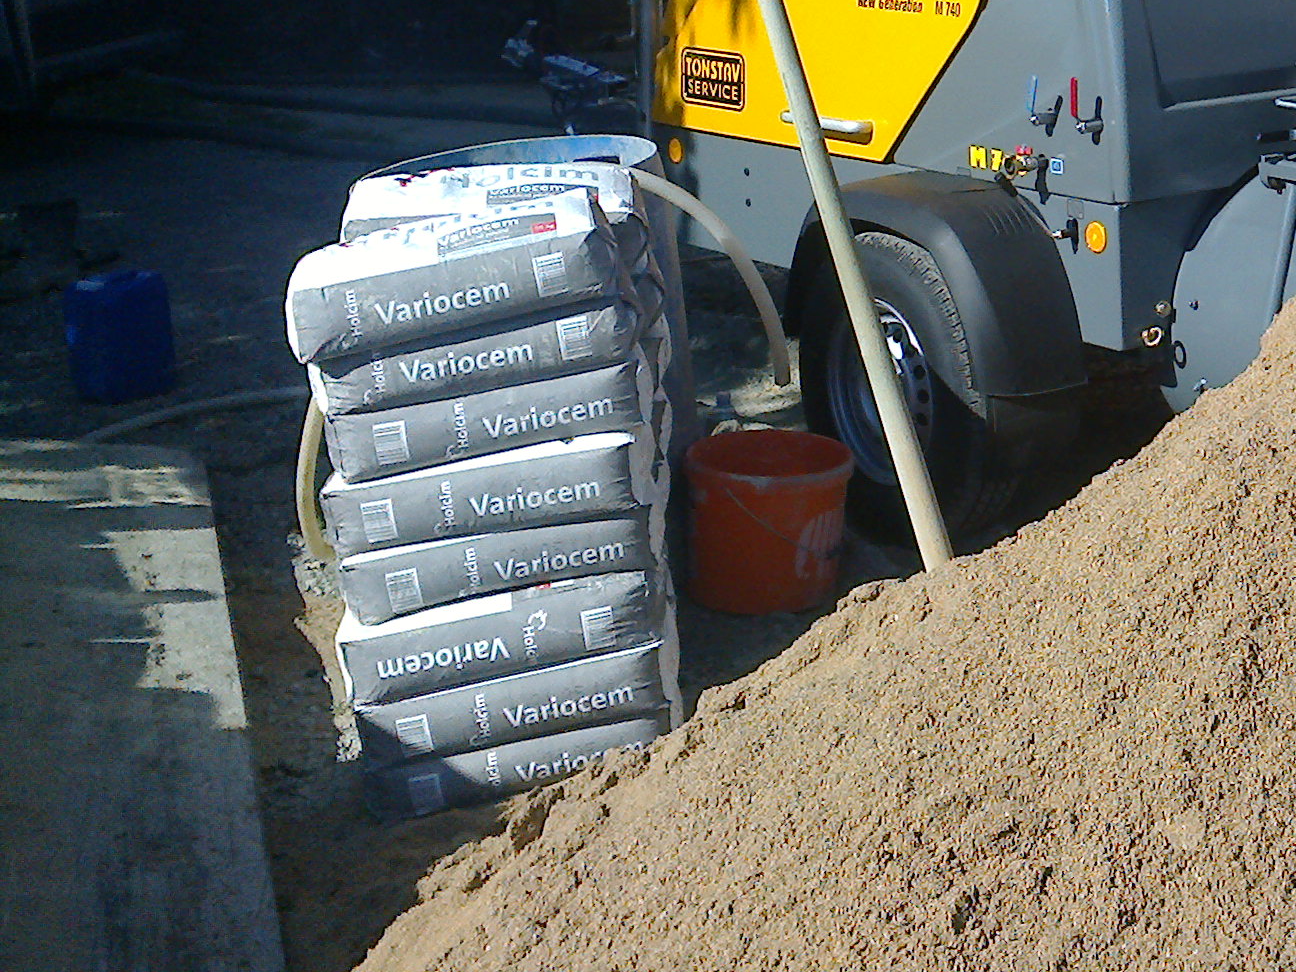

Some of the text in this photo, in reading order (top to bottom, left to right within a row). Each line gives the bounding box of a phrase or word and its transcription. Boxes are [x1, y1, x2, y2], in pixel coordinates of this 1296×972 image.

[935, 0, 944, 15] M
[946, 1, 961, 18] 740
[685, 56, 741, 83] TONSTAV
[687, 78, 740, 101] SERVICE
[969, 144, 988, 170] M
[437, 217, 521, 245] Variocem
[344, 288, 363, 338] Holcim
[373, 280, 511, 326] Variocem
[398, 343, 533, 384] Variocem
[453, 400, 469, 449] Holcim
[481, 397, 614, 440] Variocem
[438, 480, 456, 528] Holcim
[468, 480, 601, 518] Variocem
[493, 541, 625, 581] Variocem
[376, 636, 511, 680] Variocem
[471, 692, 492, 737] Holcim
[502, 685, 634, 729] Variocem
